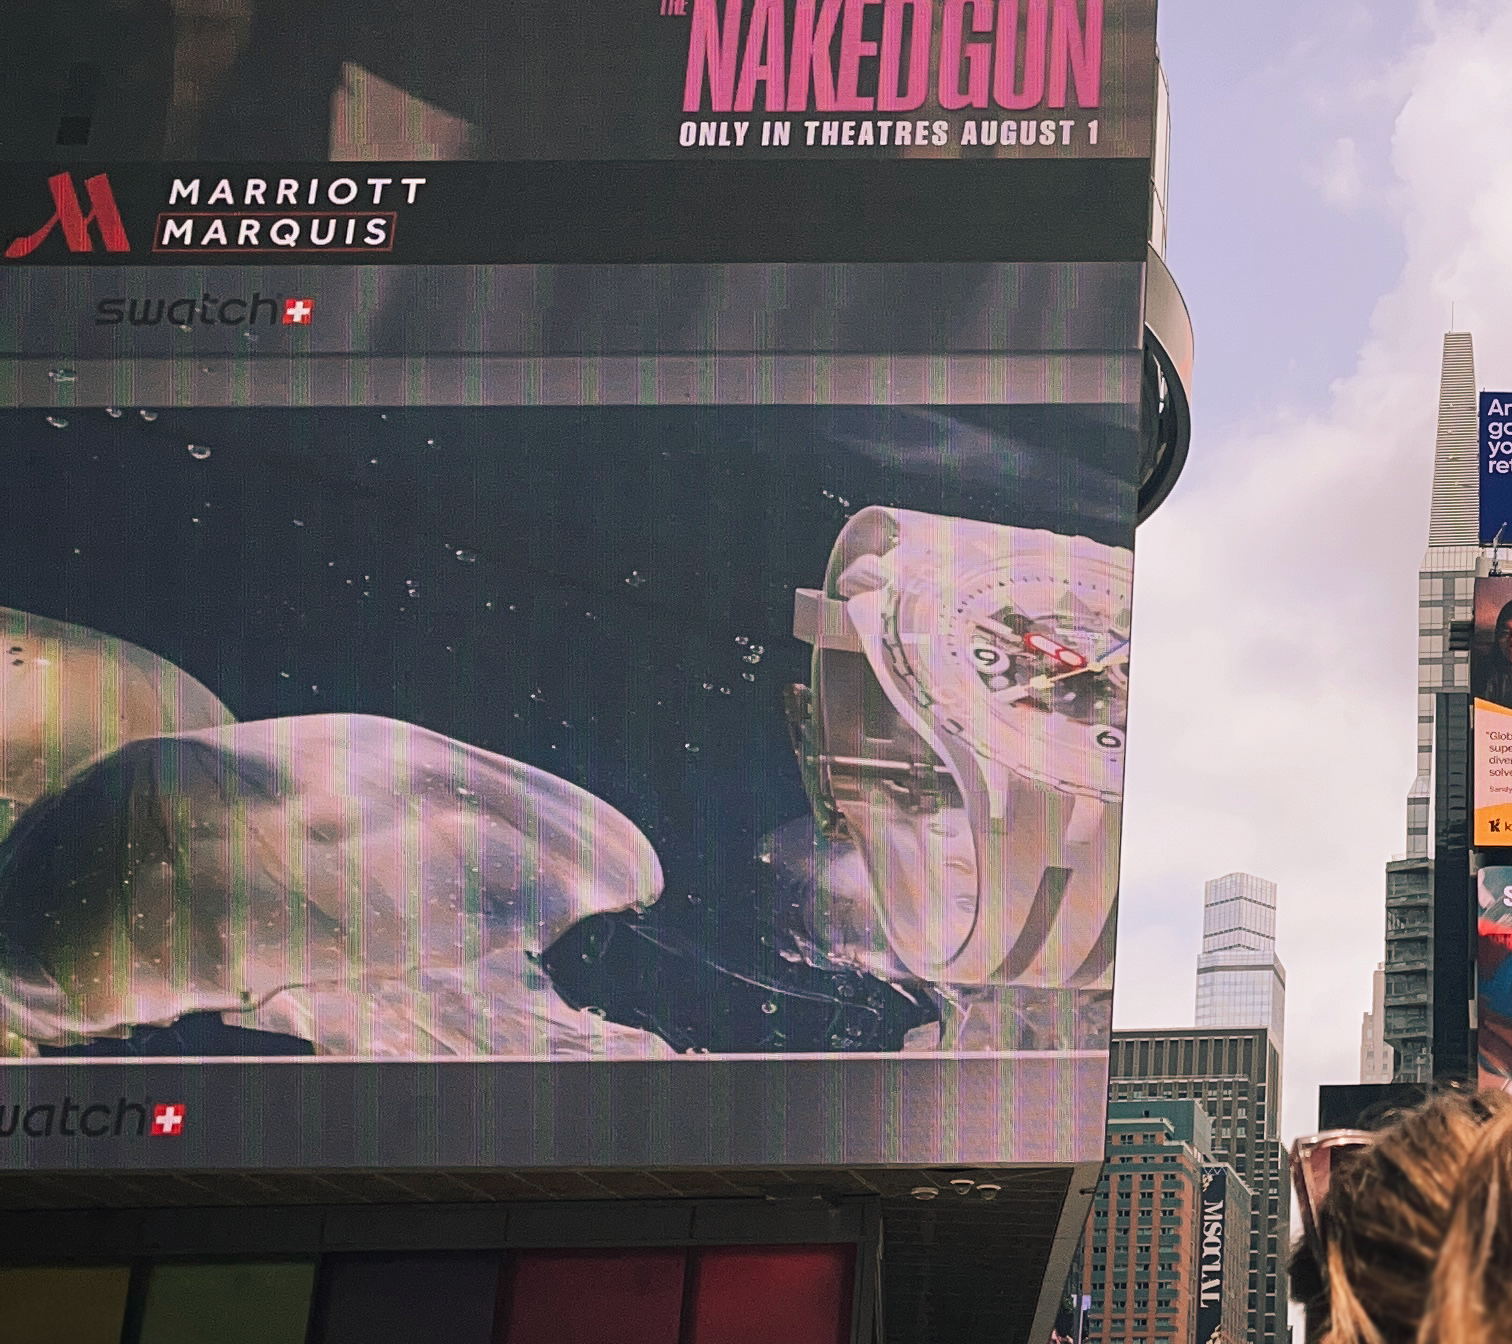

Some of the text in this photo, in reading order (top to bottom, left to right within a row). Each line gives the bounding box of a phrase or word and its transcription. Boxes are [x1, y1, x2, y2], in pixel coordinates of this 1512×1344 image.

[679, 118, 1099, 148] ONLY IN THEATRES AUGUST 1
[168, 177, 427, 206] MARRIOTT
[160, 217, 388, 248] MARQUIS
[98, 292, 279, 327] swatch
